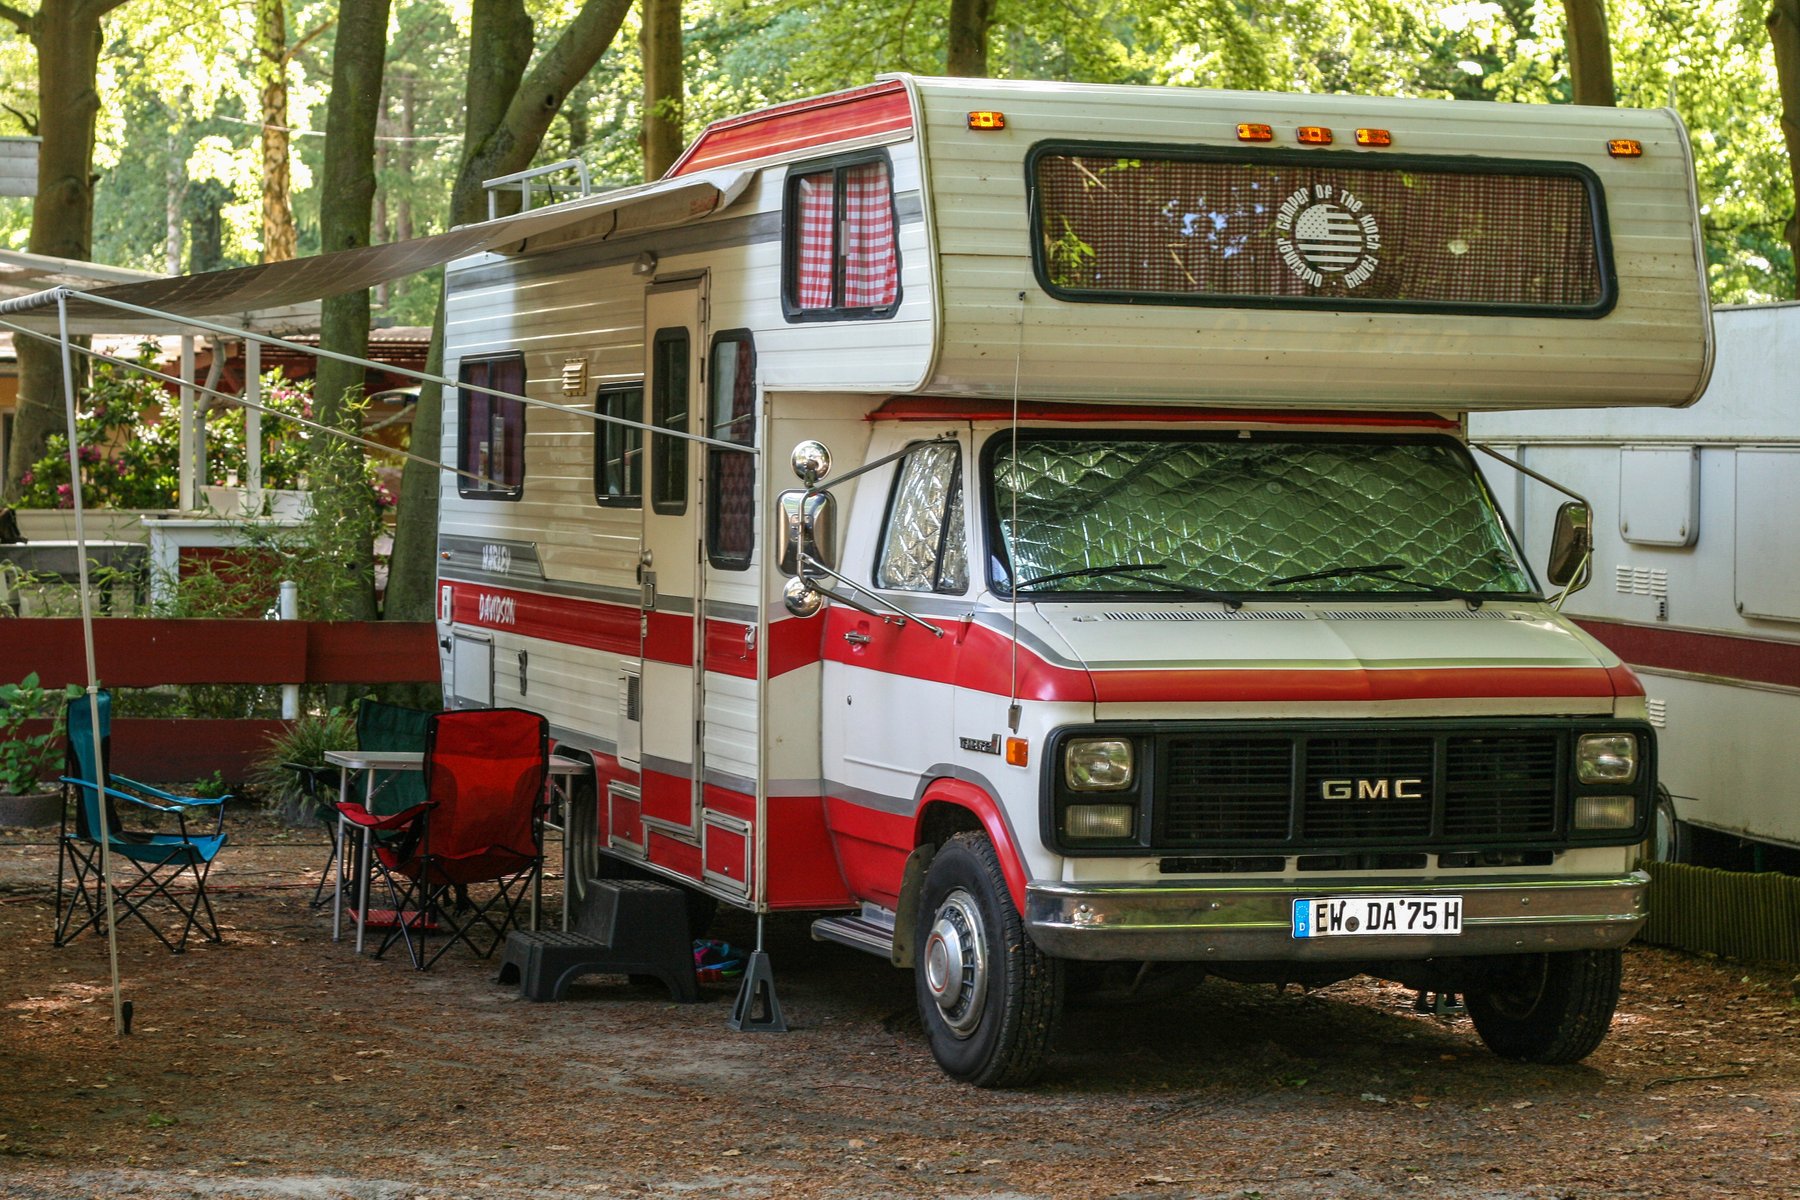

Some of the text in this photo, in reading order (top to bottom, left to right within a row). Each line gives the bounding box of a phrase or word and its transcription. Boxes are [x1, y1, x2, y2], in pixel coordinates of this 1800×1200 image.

[1276, 187, 1309, 231] Camper
[1340, 189, 1363, 213] The
[1276, 237, 1323, 288] Oldtimer
[1344, 254, 1379, 289] Family
[481, 544, 511, 573] HARLEY
[478, 593, 516, 625] DAVIDSON
[1322, 779, 1422, 799] GMC
[1299, 922, 1306, 932] D
[1315, 902, 1346, 932] EW
